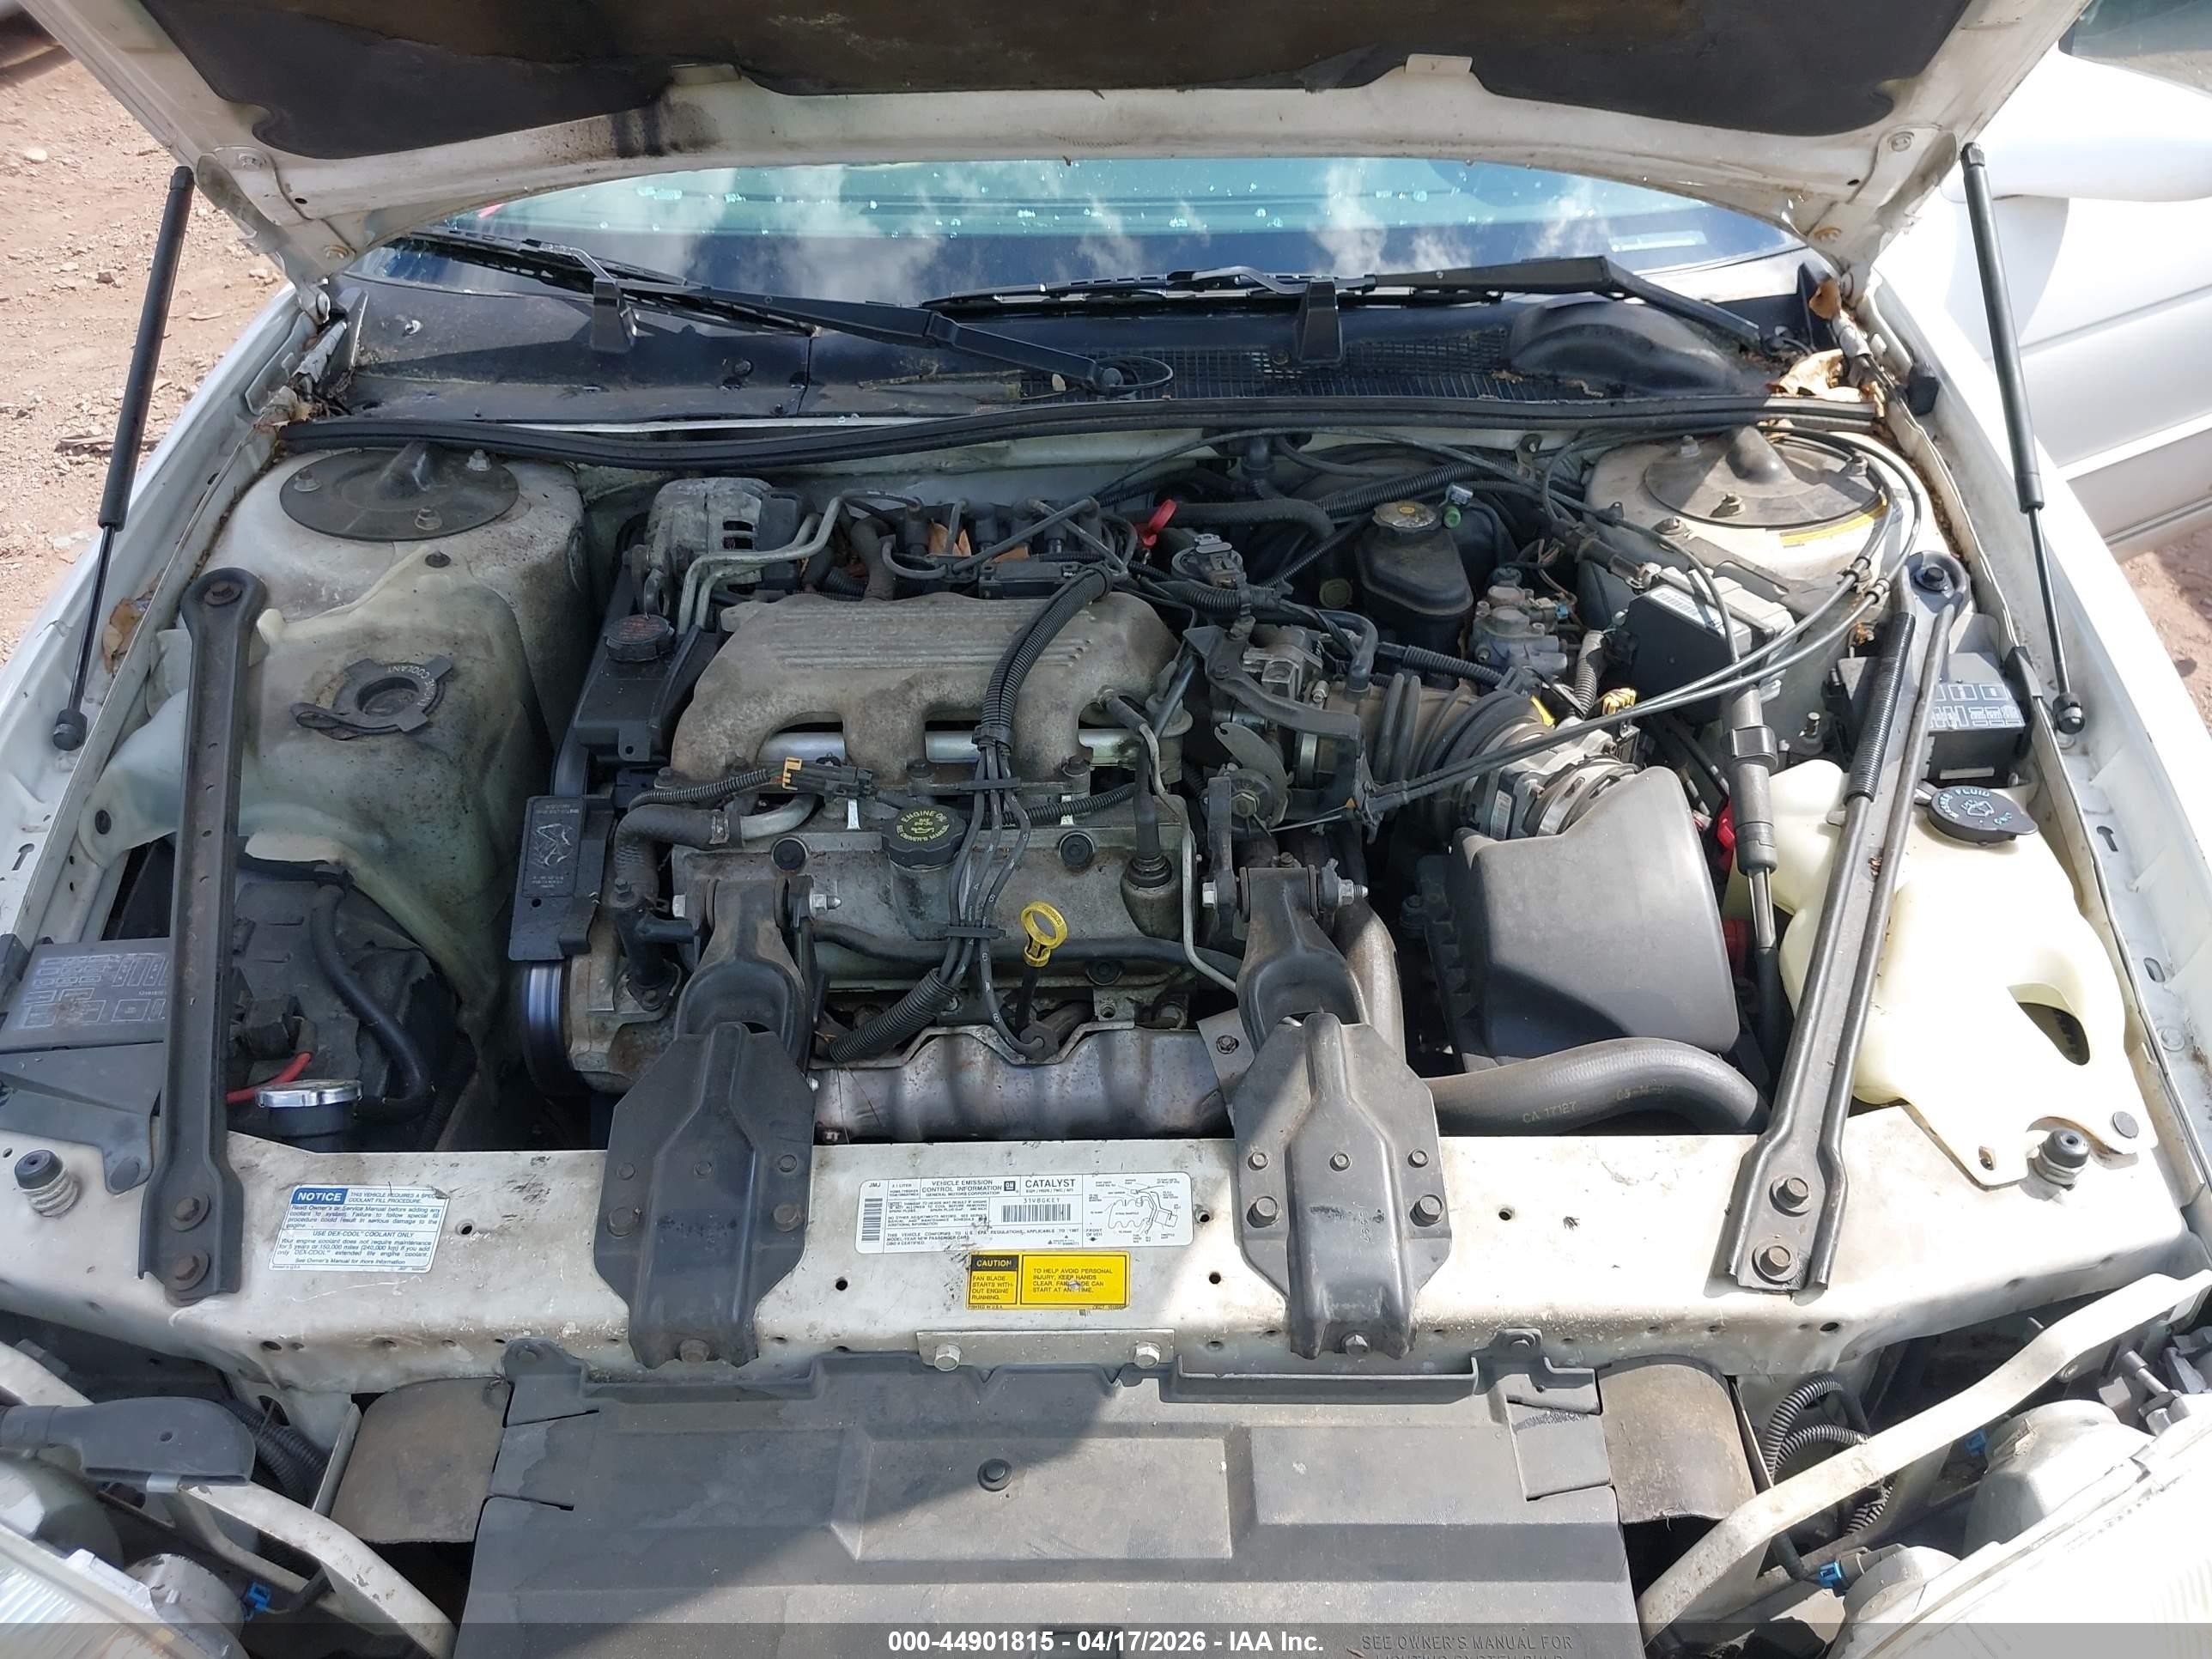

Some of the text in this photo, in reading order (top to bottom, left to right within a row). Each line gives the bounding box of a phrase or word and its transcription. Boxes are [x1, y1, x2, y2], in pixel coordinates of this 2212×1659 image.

[1955, 788, 1990, 797] FLUID
[901, 811, 936, 823] ENGINE
[988, 894, 996, 902] 6
[981, 952, 988, 962] 6
[993, 1013, 1000, 1023] 6
[1025, 1179, 1076, 1188] CATALYST
[297, 1192, 343, 1201] NOTICE
[1362, 1636, 1574, 1650] SEE OWNER'S MANUAL FOR
